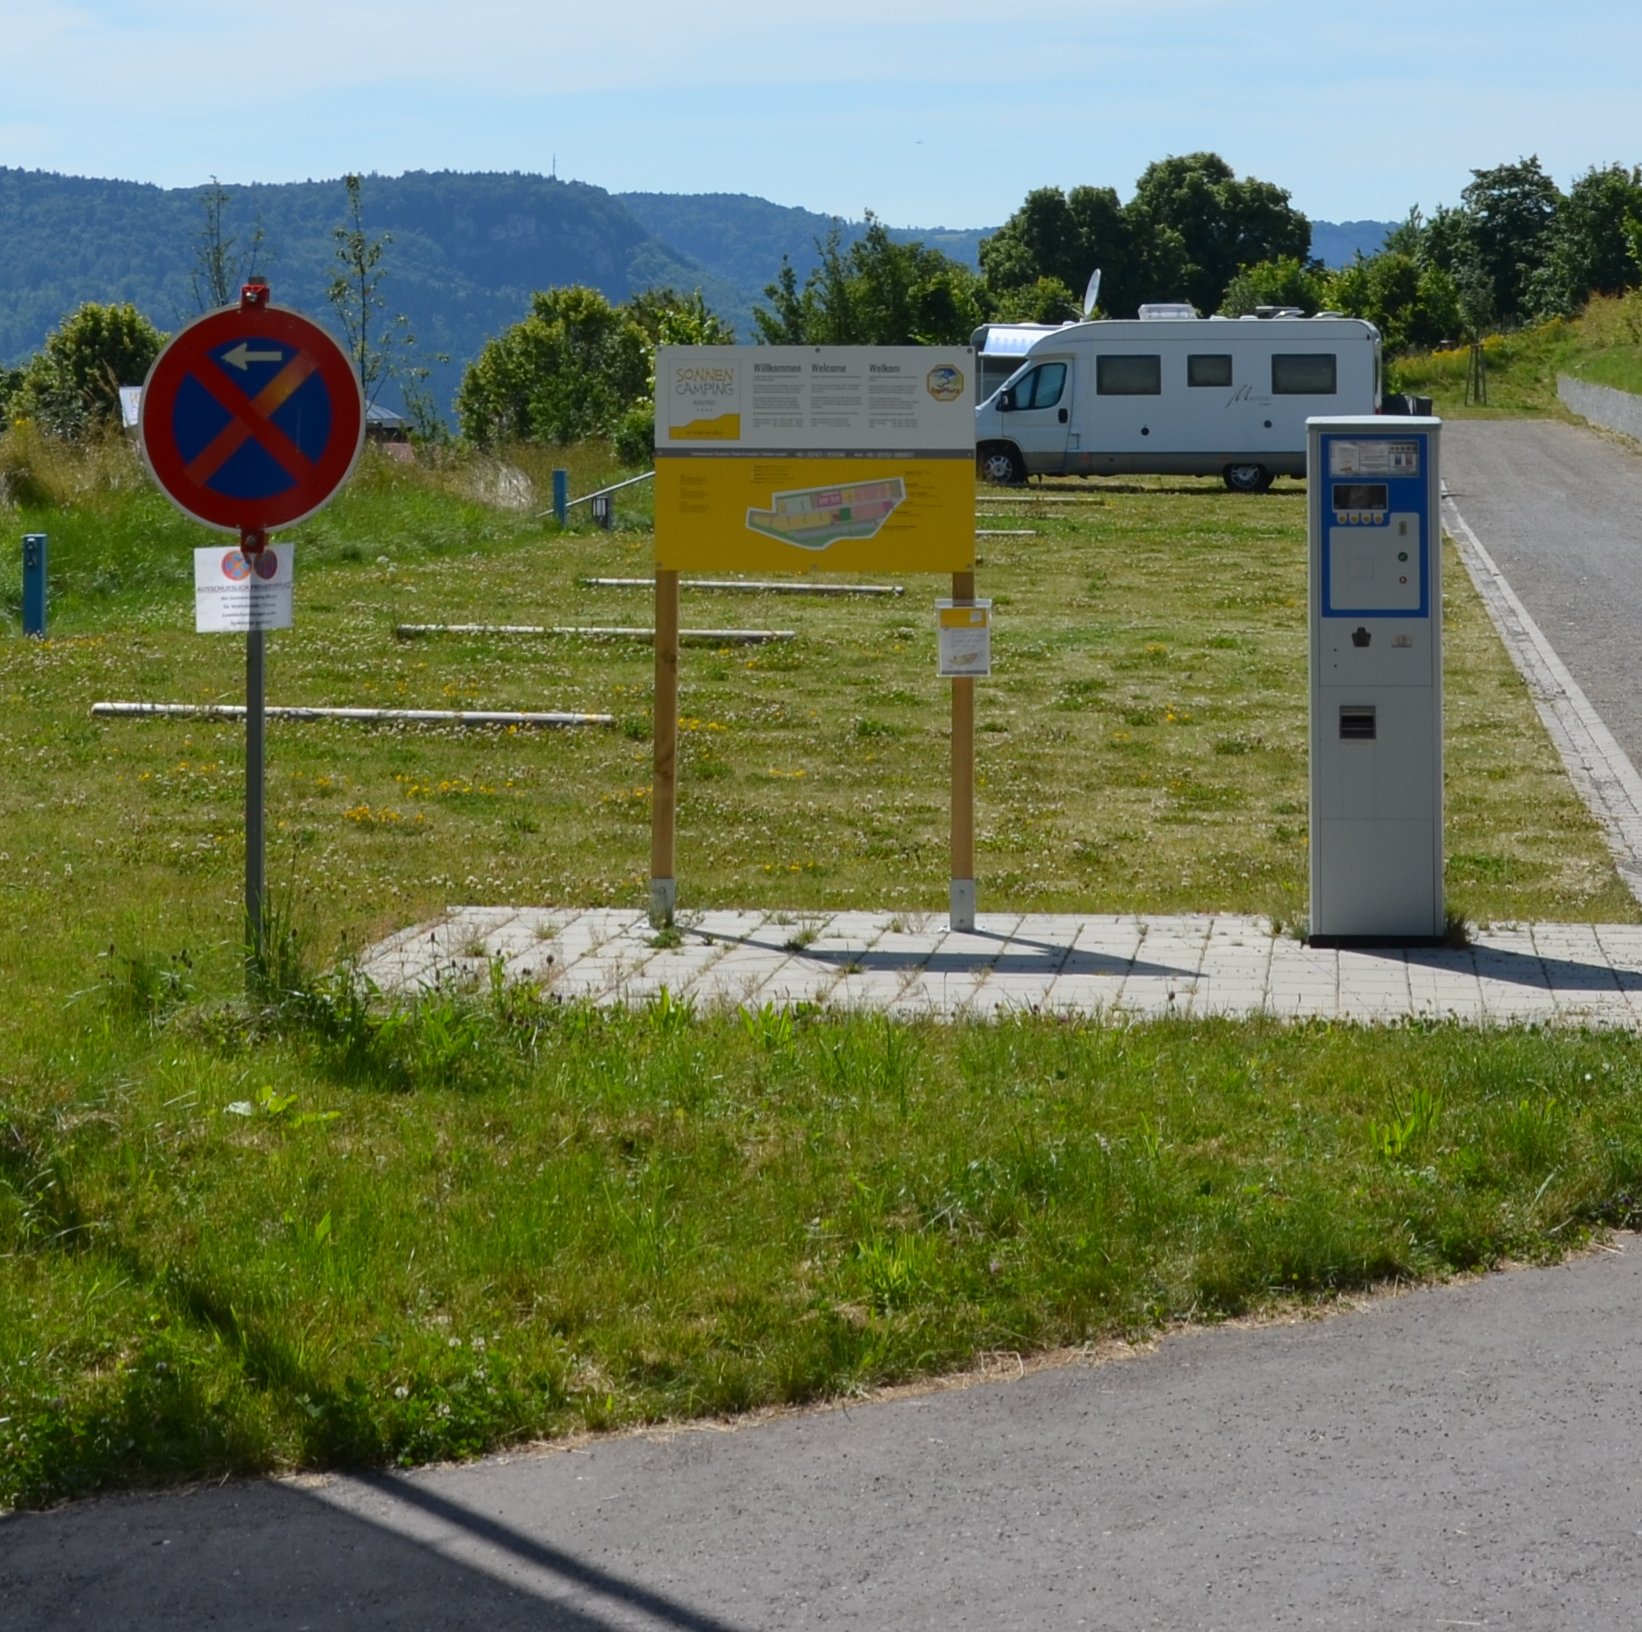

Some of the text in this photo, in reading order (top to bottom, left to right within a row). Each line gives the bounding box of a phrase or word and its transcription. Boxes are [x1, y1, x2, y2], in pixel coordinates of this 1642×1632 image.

[753, 363, 802, 373] Willkommen
[811, 363, 847, 373] Welcome
[869, 363, 901, 373] Welkom
[675, 367, 734, 383] SONNEN
[675, 382, 734, 396] CAMPING
